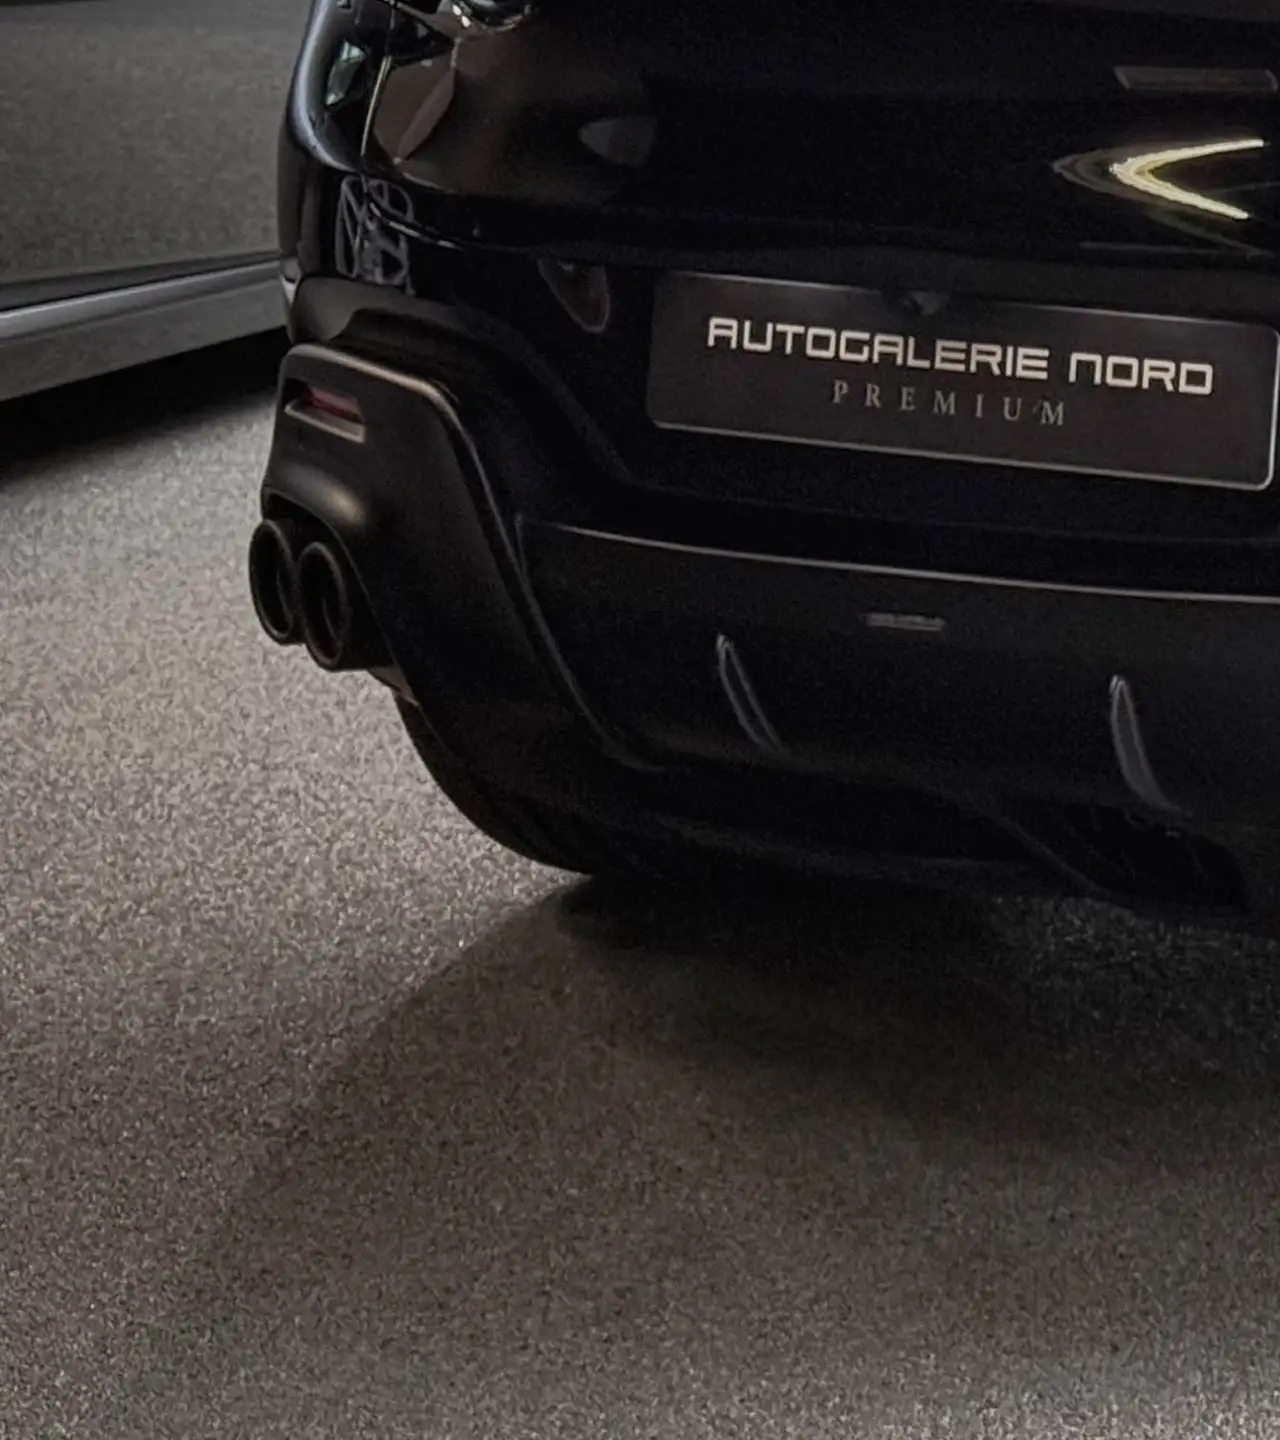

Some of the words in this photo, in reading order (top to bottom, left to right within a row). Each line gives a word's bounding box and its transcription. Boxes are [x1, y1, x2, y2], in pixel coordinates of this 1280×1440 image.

[706, 315, 1050, 381] AUTOGALERIE
[1067, 350, 1214, 397] NORD
[832, 378, 1065, 427] PREMIUM
